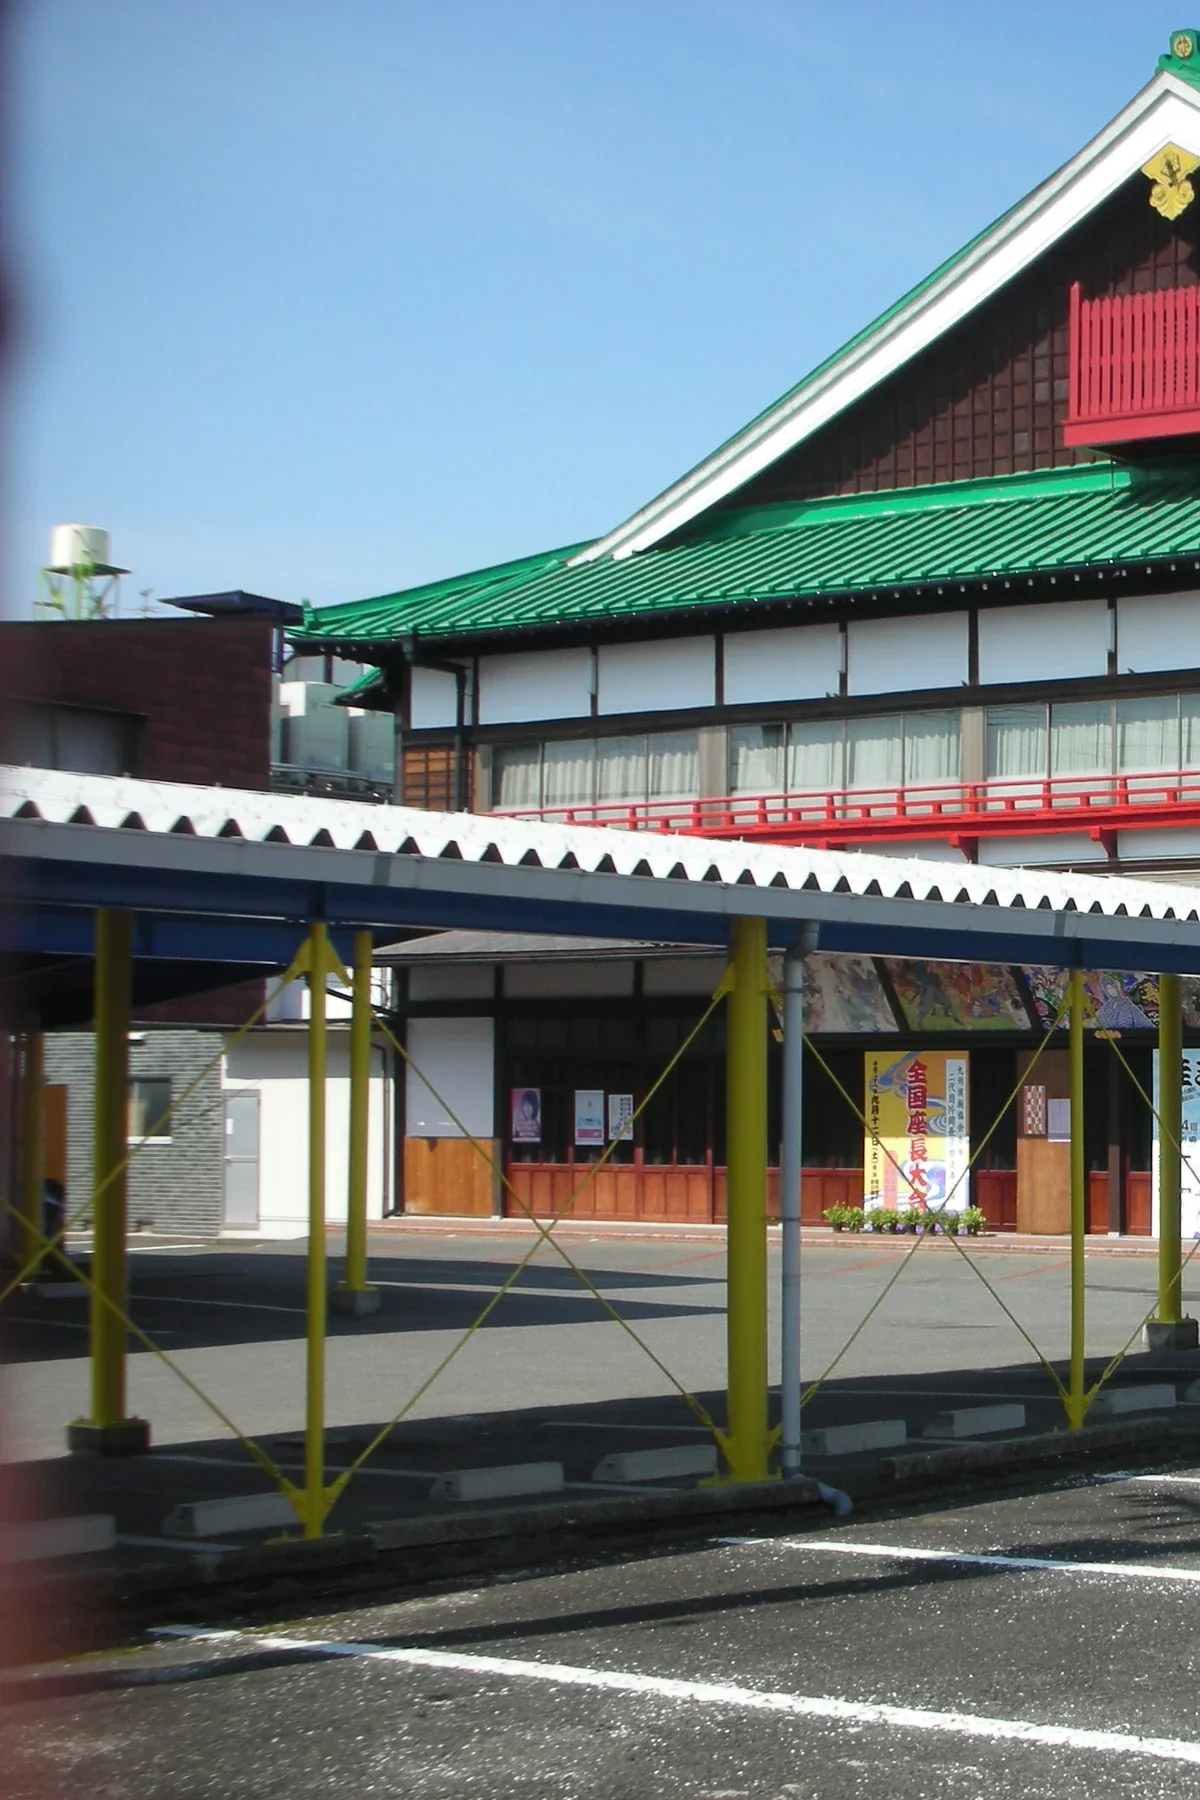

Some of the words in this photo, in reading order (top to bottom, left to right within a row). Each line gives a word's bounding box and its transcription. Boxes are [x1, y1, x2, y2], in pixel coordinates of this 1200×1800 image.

[907, 1059, 928, 1212] 全国座長大会
